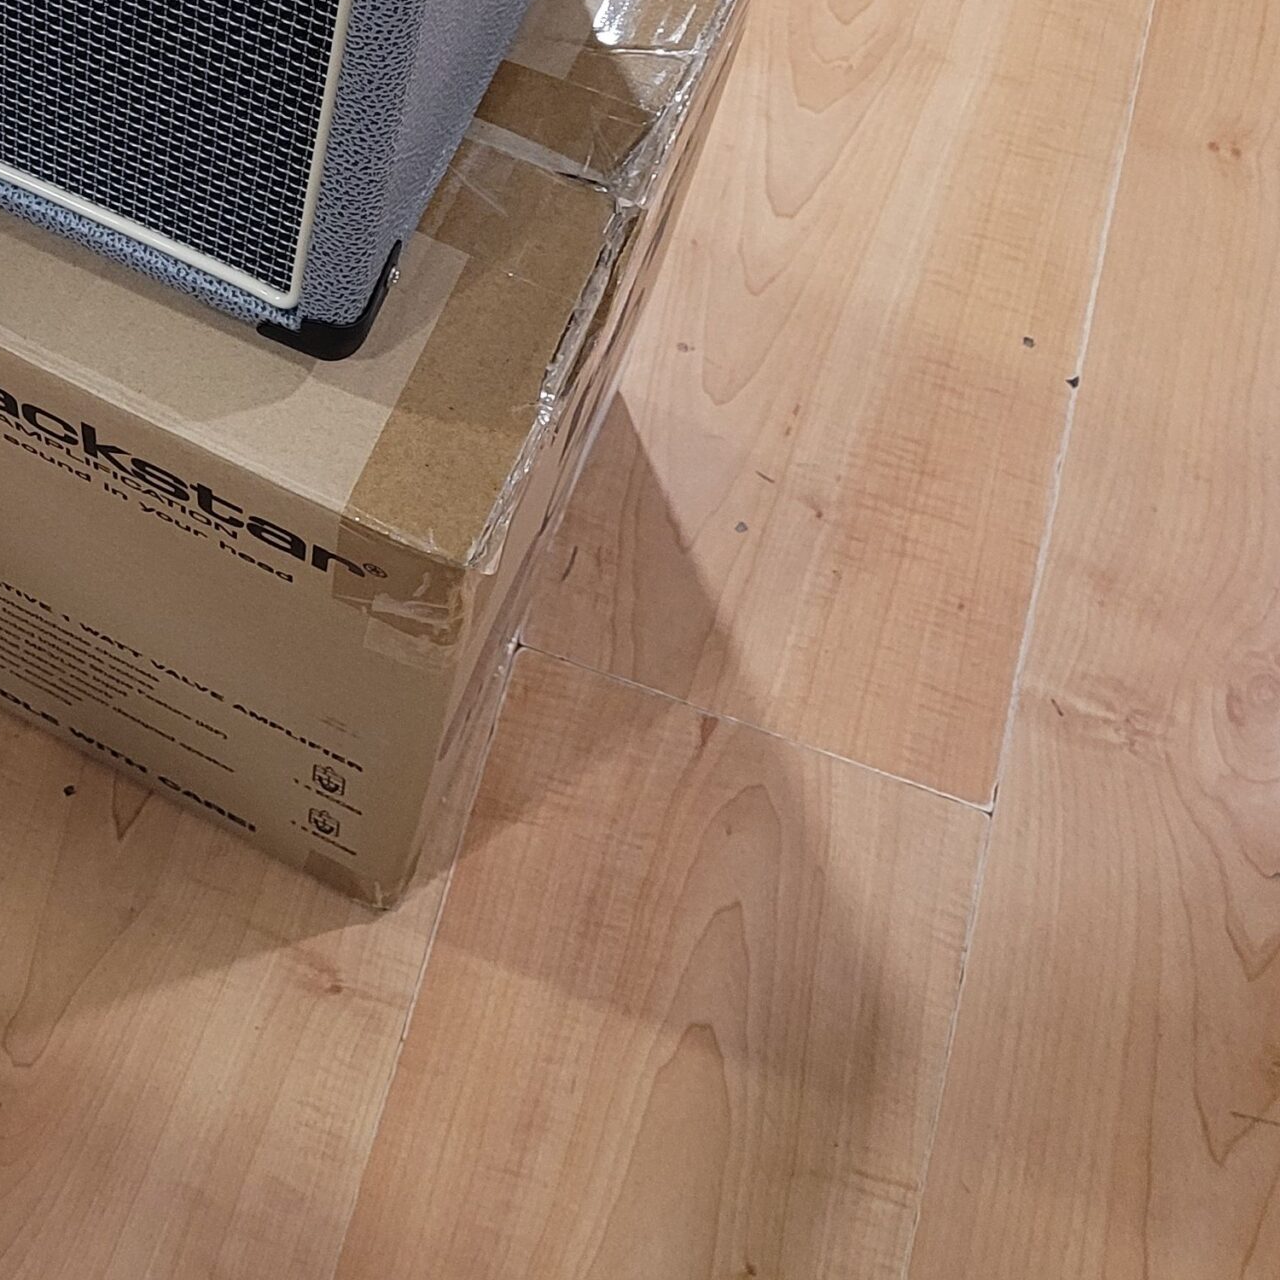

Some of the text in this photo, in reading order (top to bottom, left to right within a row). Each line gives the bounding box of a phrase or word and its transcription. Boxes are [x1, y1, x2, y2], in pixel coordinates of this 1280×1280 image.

[3, 433, 92, 483] sound
[103, 482, 128, 501] in
[138, 501, 208, 538] your
[219, 540, 294, 583] head
[68, 726, 148, 774] WITH
[79, 622, 143, 658] WATT
[150, 659, 224, 702] VALVE
[232, 704, 364, 773] AMPLIFIER
